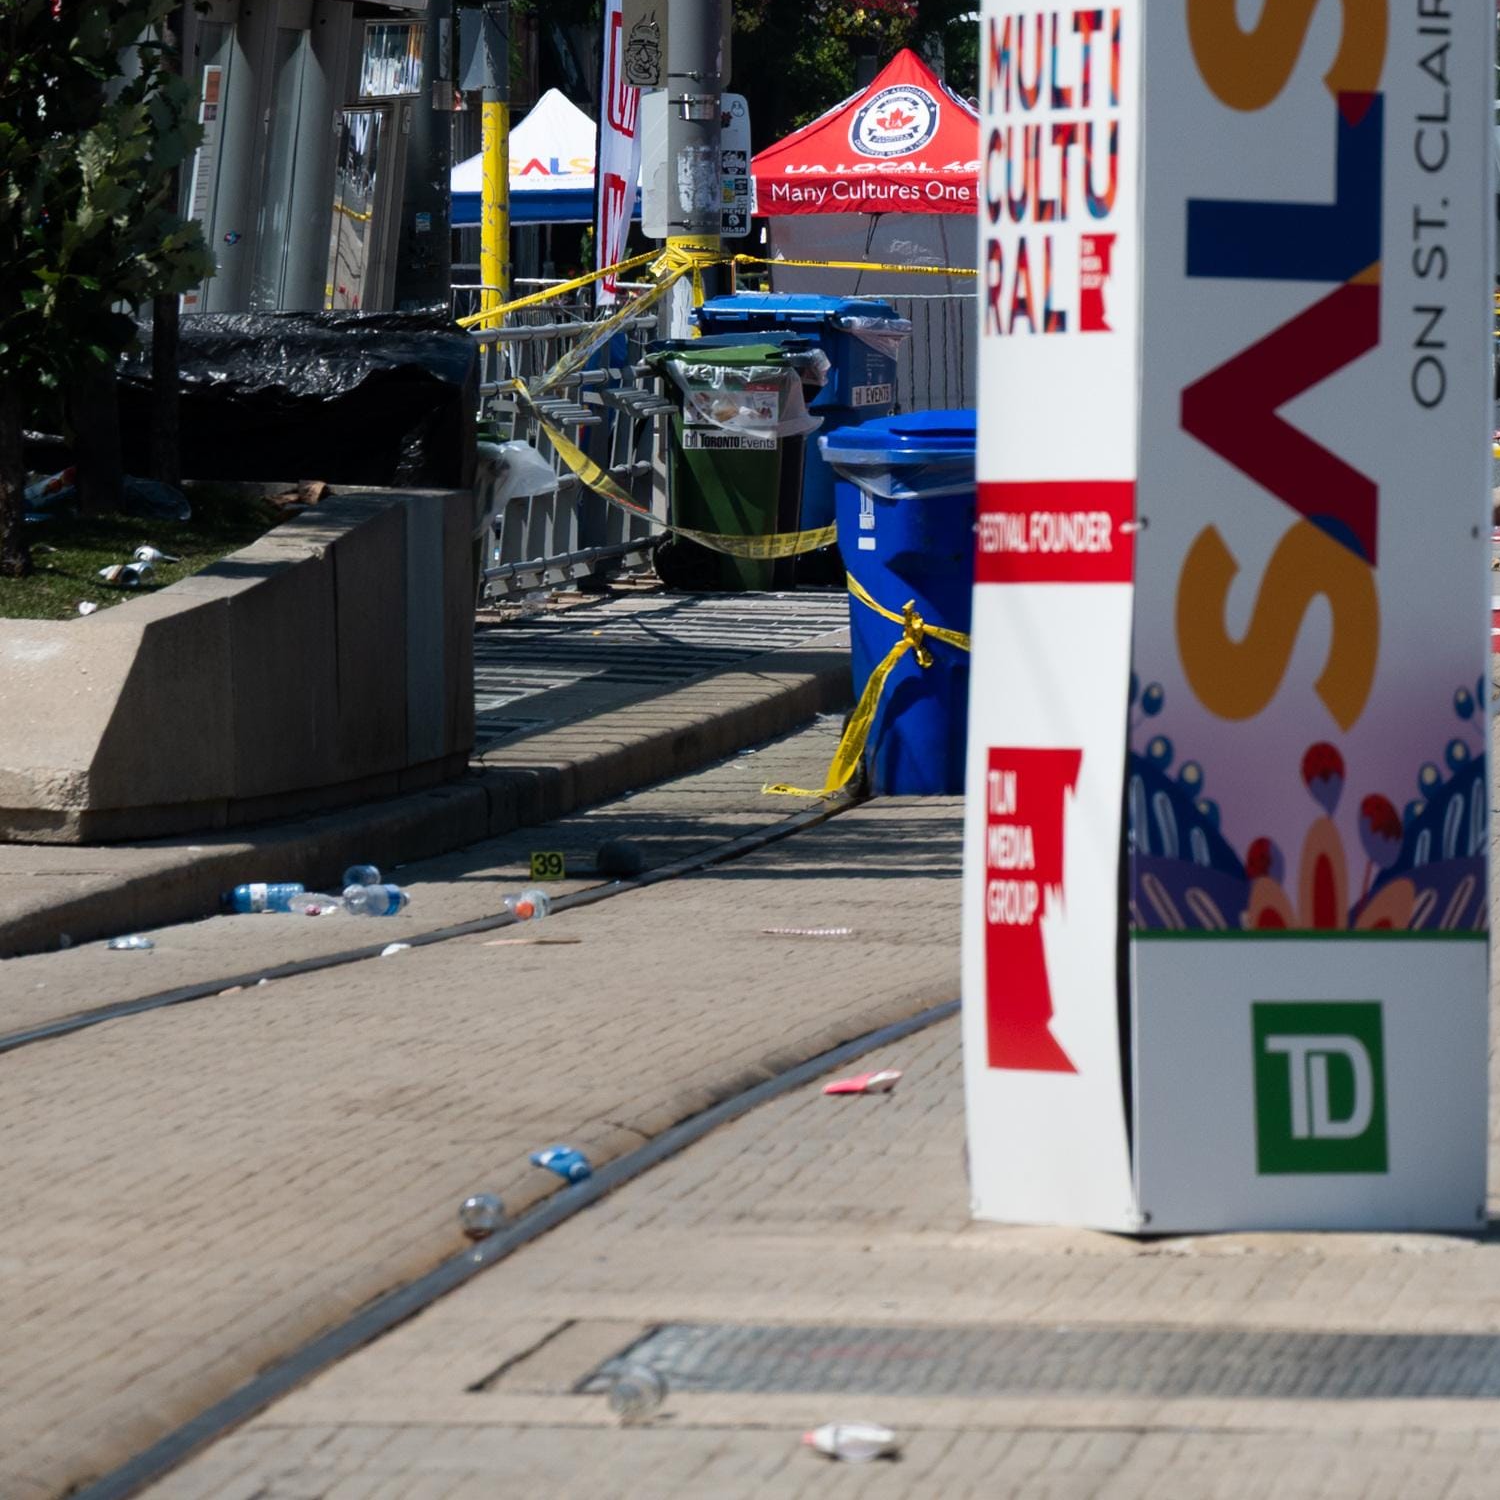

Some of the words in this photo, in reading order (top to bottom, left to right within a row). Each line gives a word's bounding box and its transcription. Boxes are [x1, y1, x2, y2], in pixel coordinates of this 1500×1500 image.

[987, 8, 1121, 113] MULTI
[509, 158, 595, 175] SALS
[837, 161, 927, 173] LOCAL
[985, 121, 1118, 226] CULTU
[772, 183, 827, 204] Many
[833, 180, 919, 200] Cultures
[926, 181, 970, 200] One
[1413, 195, 1450, 281] ST.
[985, 235, 1066, 336] RAL
[1411, 304, 1447, 410] ON
[866, 385, 891, 403] EVENTS
[700, 432, 739, 448] TORONTO
[741, 433, 775, 448] Events
[1031, 511, 1111, 553] FOUNDER
[989, 773, 1016, 814] TLN
[534, 853, 563, 876] 39
[989, 827, 1034, 870] MEDIA
[988, 882, 1037, 926] GROUP
[1267, 1035, 1373, 1138] TD
